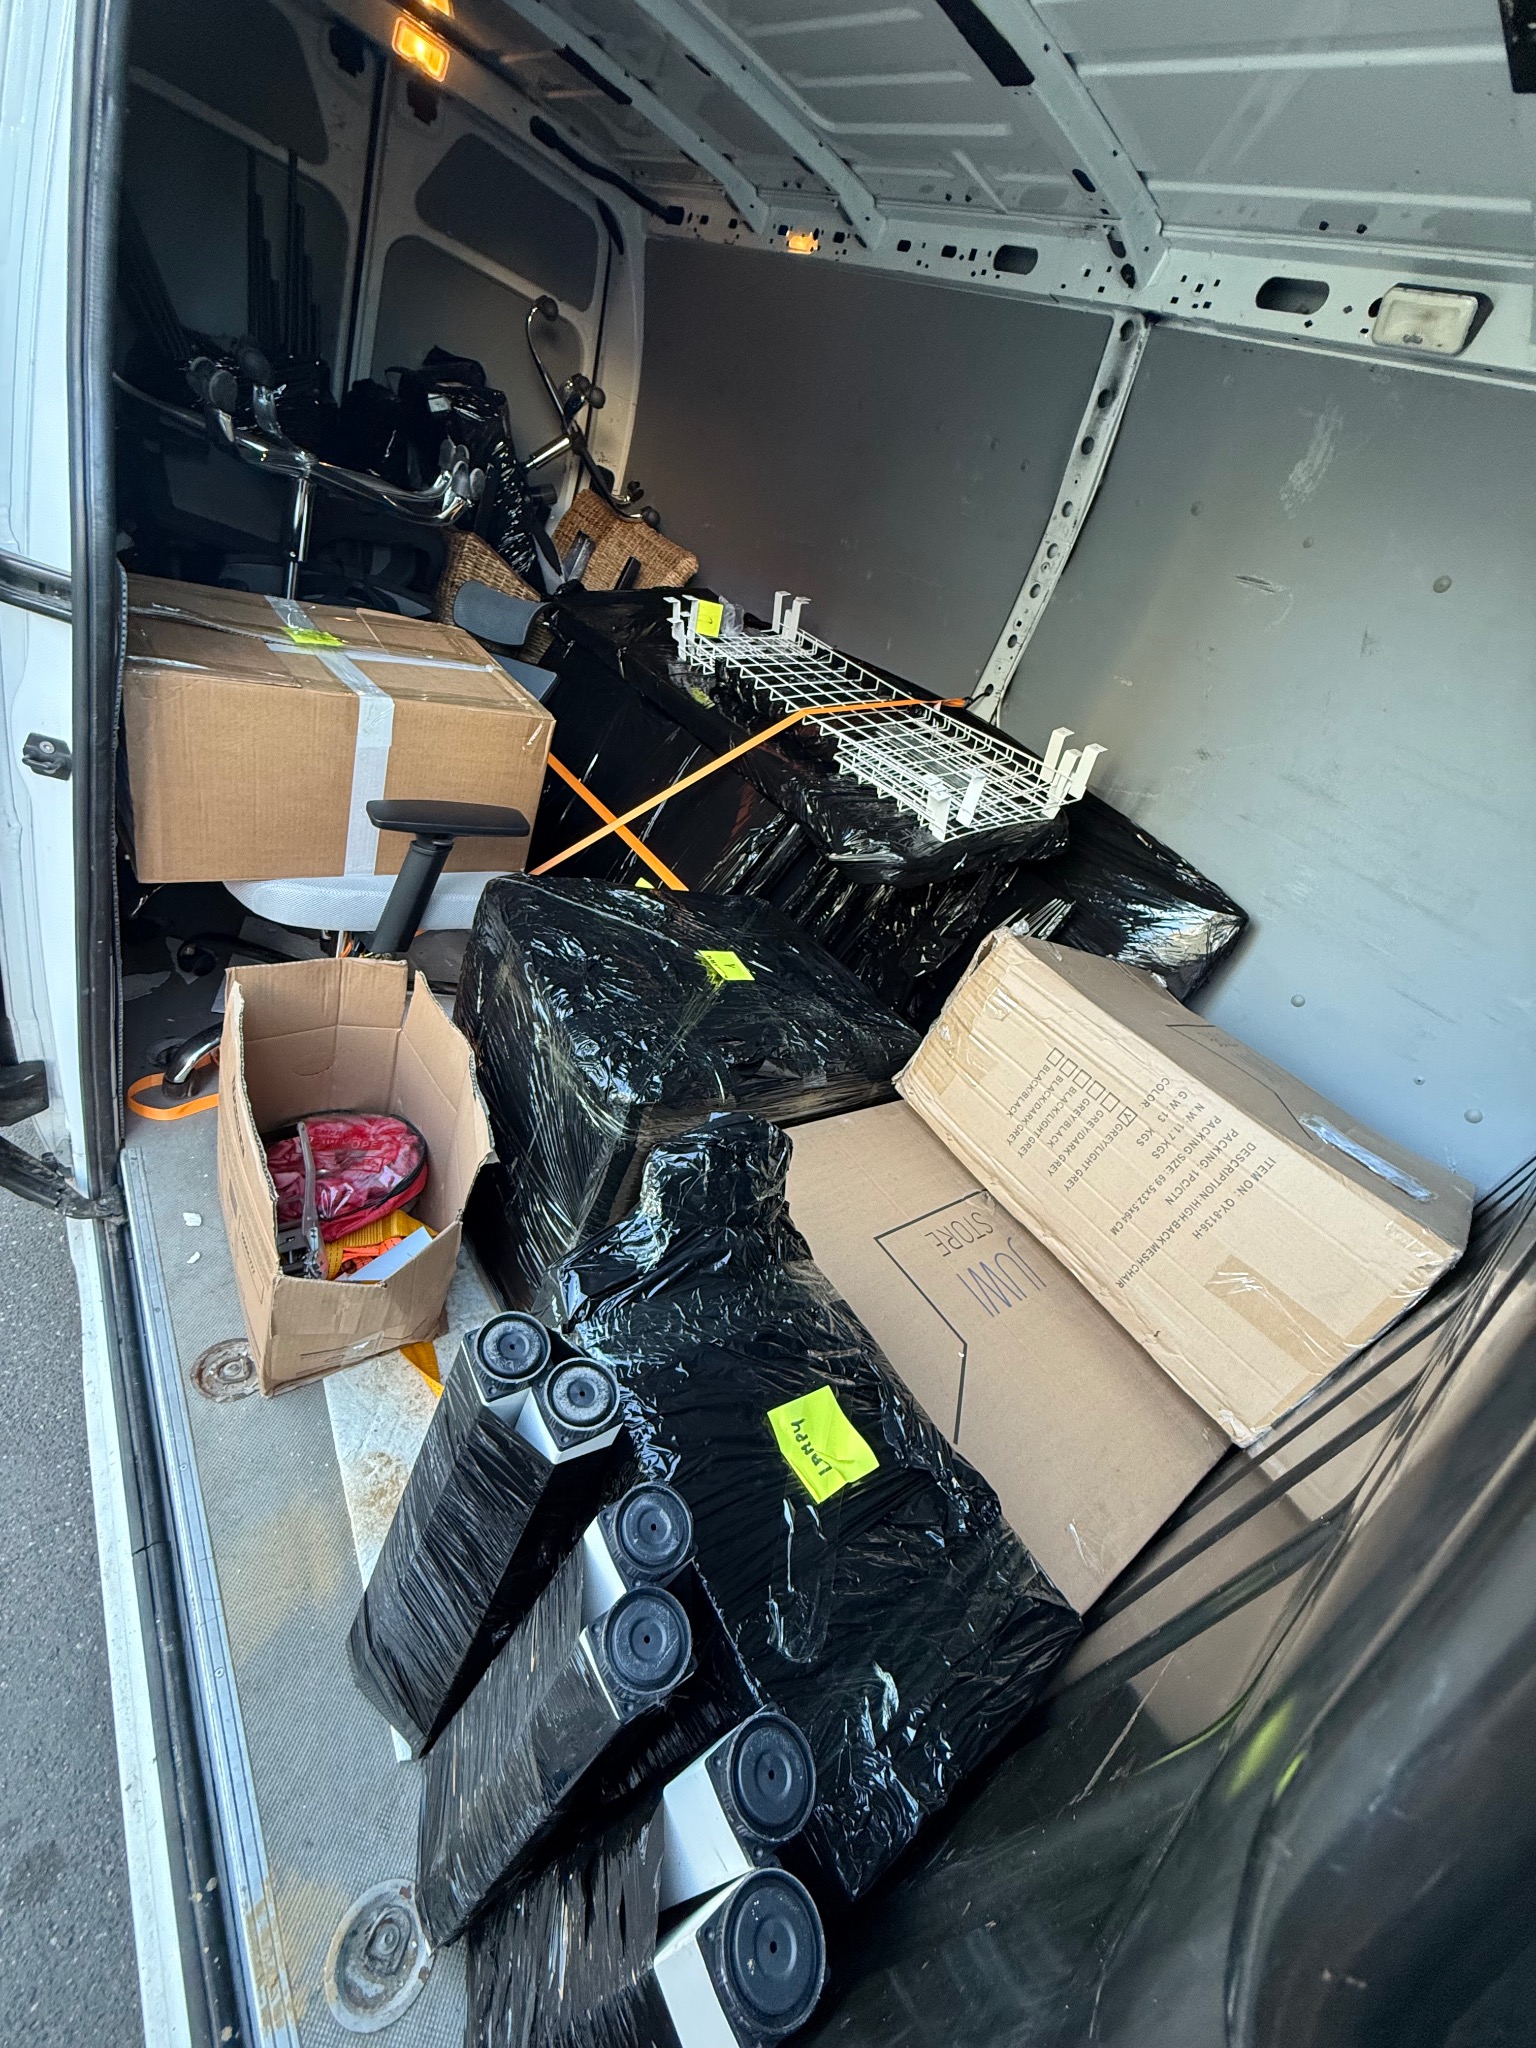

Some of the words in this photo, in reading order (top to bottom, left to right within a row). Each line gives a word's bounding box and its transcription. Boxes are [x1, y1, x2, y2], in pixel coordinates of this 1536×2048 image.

[1006, 1064, 1050, 1118] BLACK/BLACK
[1022, 1075, 1063, 1125] BLACK/DARK
[1139, 1077, 1170, 1108] COLOR:
[1034, 1086, 1077, 1138] BLACK/LIGHT
[1046, 1098, 1090, 1148] GREY/BLACK
[1157, 1111, 1169, 1122] 13
[1006, 1124, 1024, 1146] GREY
[1063, 1110, 1104, 1156] GREY/DARK
[1135, 1126, 1154, 1146] KGS
[1166, 1123, 1184, 1141] 11.7
[1183, 1116, 1221, 1157] PACKING
[1017, 1136, 1035, 1158] GREY
[1081, 1123, 1123, 1171] GREY/LIGHT
[1151, 1140, 1169, 1159] KGS
[1196, 1128, 1239, 1170] PACKING:
[1047, 1154, 1066, 1176] GREY
[1163, 1152, 1185, 1176] SIZE:
[1250, 1156, 1277, 1182] ITEM
[1063, 1169, 1083, 1192] GREY
[1164, 1168, 1199, 1206] 1PC/CTN
[1234, 1178, 1253, 1197] ON:
[1109, 1219, 1124, 1235] CM
[1191, 1197, 1235, 1240] QY-8136-H
[924, 1212, 994, 1257] STORE
[1137, 1241, 1159, 1267] MESH
[956, 1236, 1047, 1318] JUWI
[1115, 1262, 1140, 1289] CHAIR
